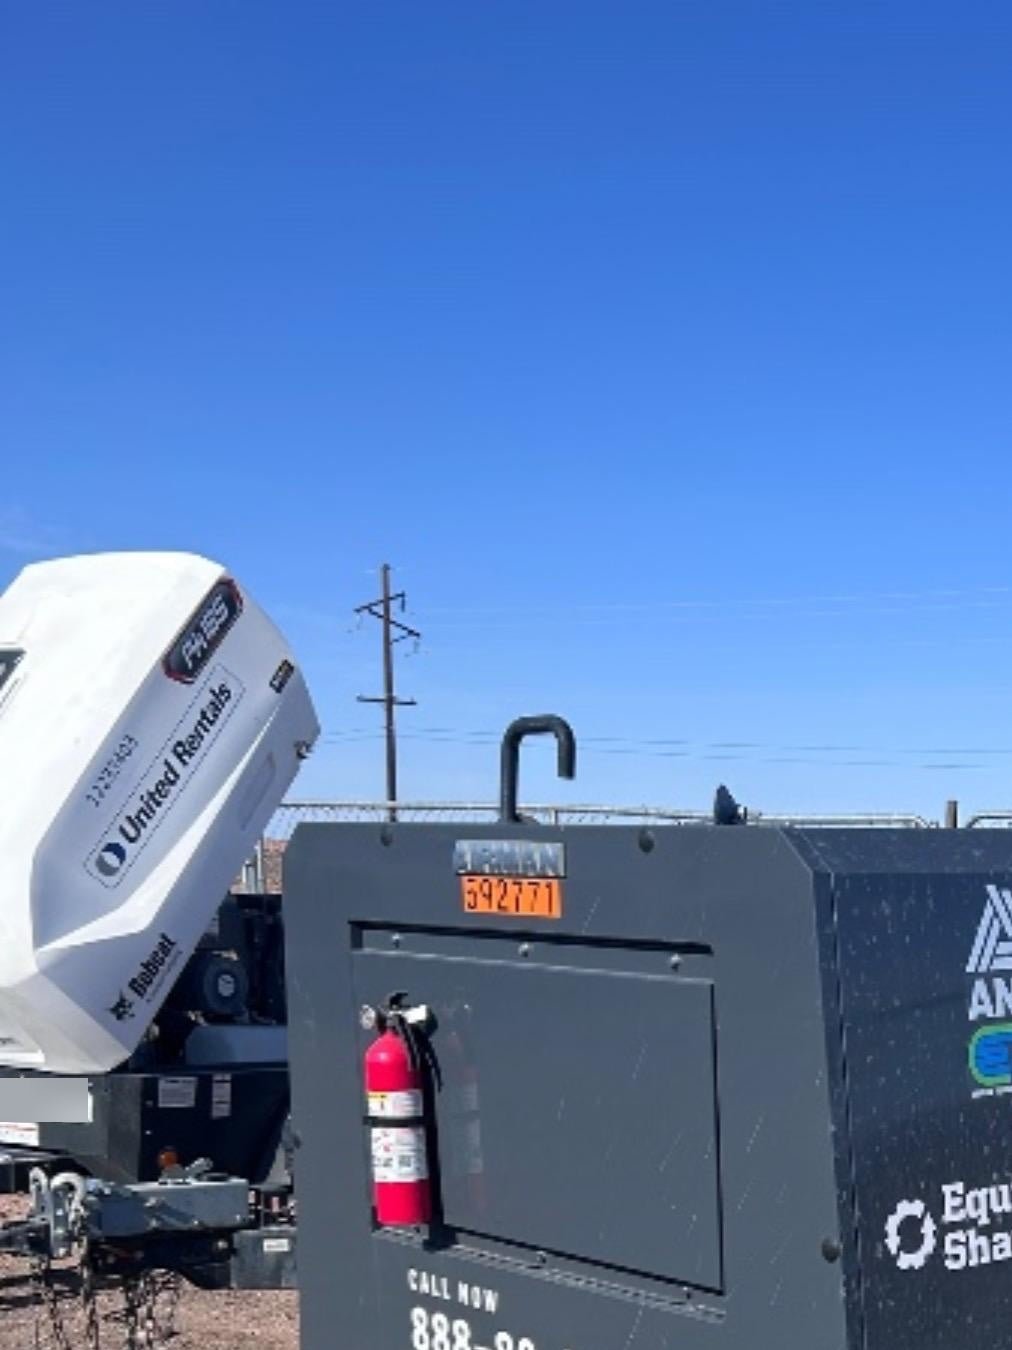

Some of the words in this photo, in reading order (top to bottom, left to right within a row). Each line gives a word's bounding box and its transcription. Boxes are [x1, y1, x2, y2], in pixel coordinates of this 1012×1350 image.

[119, 758, 180, 844] United
[172, 683, 233, 766] Rentals
[466, 878, 552, 914] 592771
[128, 932, 176, 998] Bobcat
[407, 1267, 451, 1300] CALL
[458, 1280, 499, 1313] NOW
